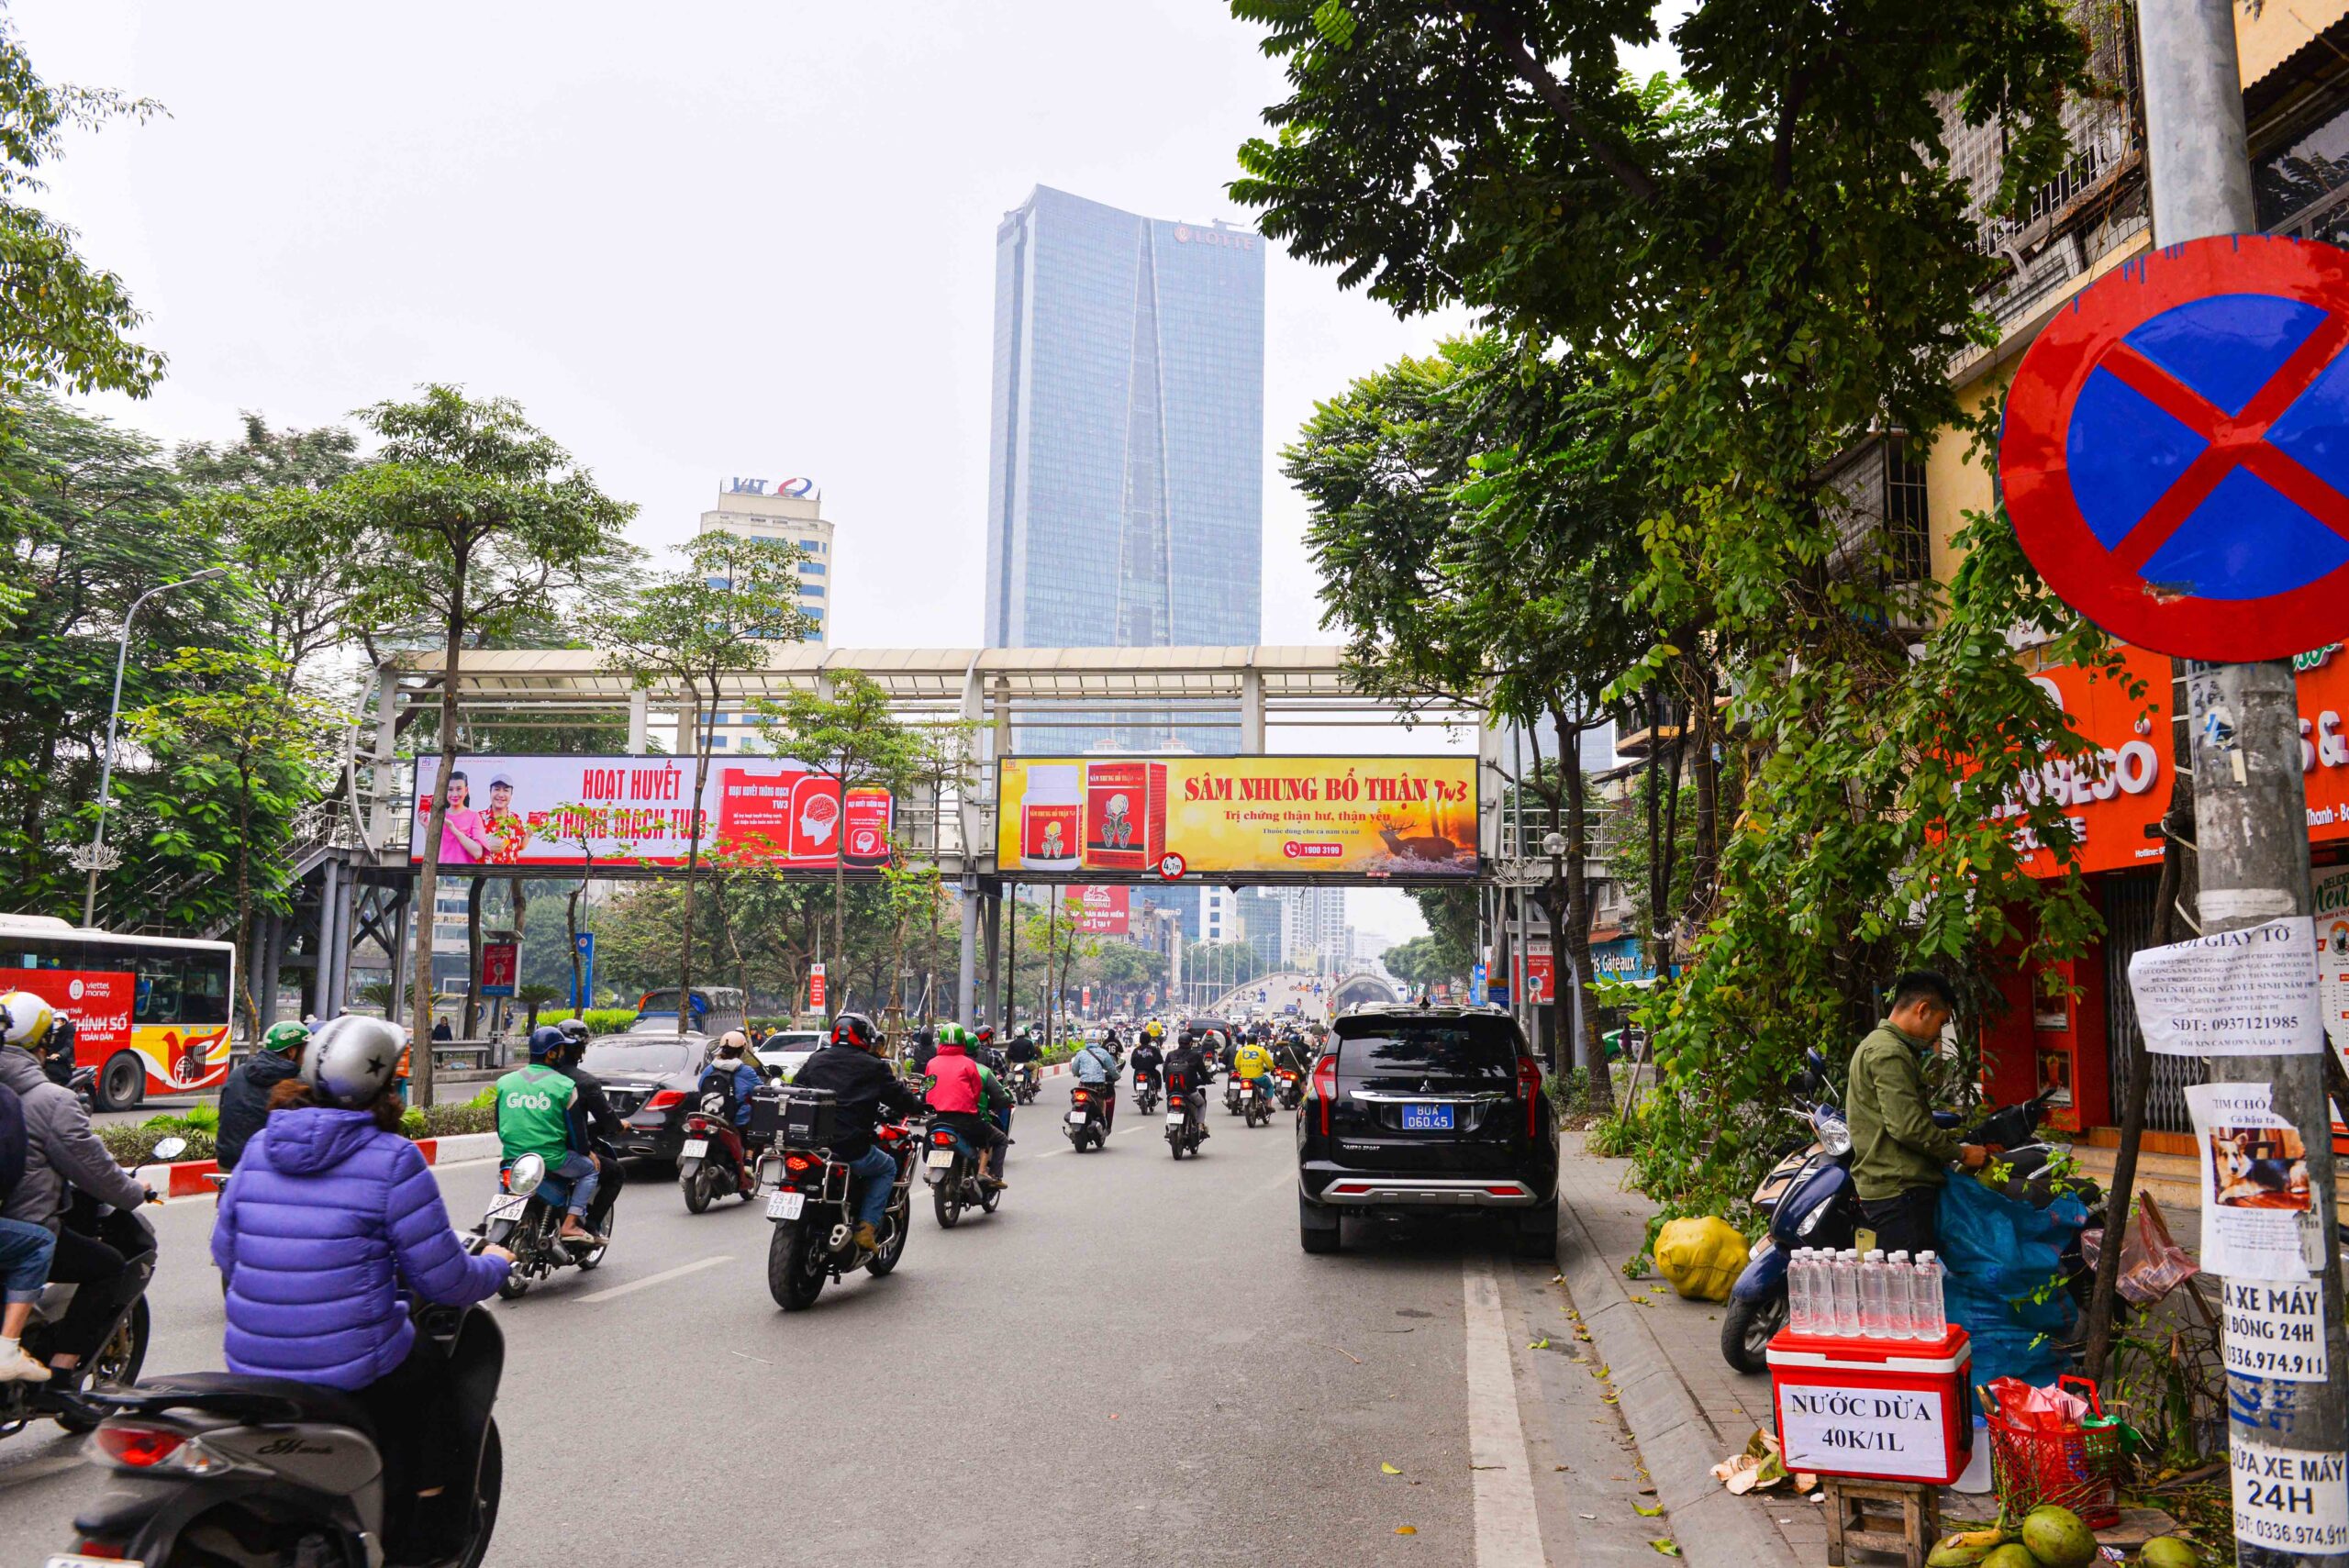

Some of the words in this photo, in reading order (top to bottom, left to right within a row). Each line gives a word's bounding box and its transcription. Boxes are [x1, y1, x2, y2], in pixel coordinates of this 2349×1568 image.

[583, 769, 626, 806] HOẠT
[630, 760, 682, 800] HUYẾT
[1185, 773, 1234, 802] SÂM
[1238, 777, 1319, 802] NHUNG
[1325, 767, 1359, 802] BỔ
[1364, 773, 1430, 810] THẬN
[1224, 810, 1241, 823] Trị
[1243, 809, 1280, 823] chứng
[1284, 810, 1311, 824] thận
[1339, 810, 1366, 824] thận
[1304, 846, 1320, 854] 1900
[1322, 846, 1340, 854] 3199
[1602, 951, 1636, 973] Gâteaux
[85, 990, 110, 998] money
[109, 1011, 128, 1030] SỐ
[2172, 1018, 2207, 1031] SĐT:
[2212, 1016, 2299, 1031] 0937121985
[1108, 1045, 1117, 1053] 16
[1242, 1048, 1259, 1060] be
[506, 1091, 551, 1110] Grab
[2234, 1096, 2266, 1109] CHÓ
[1408, 1117, 1448, 1128] 060.45
[2236, 1284, 2261, 1311] XE
[2268, 1285, 2318, 1315] MÁY
[2232, 1314, 2274, 1340] ĐỘNG
[2280, 1323, 2314, 1342] 24H
[1791, 1392, 1866, 1417] NƯỚC
[1874, 1395, 1932, 1421] DỪA
[1822, 1429, 1905, 1452] 40K/1L
[2264, 1455, 2294, 1480] XE
[2300, 1454, 2343, 1482] MÁY
[2247, 1479, 2314, 1515] 24H
[2257, 1518, 2347, 1545] 0336.974.911
